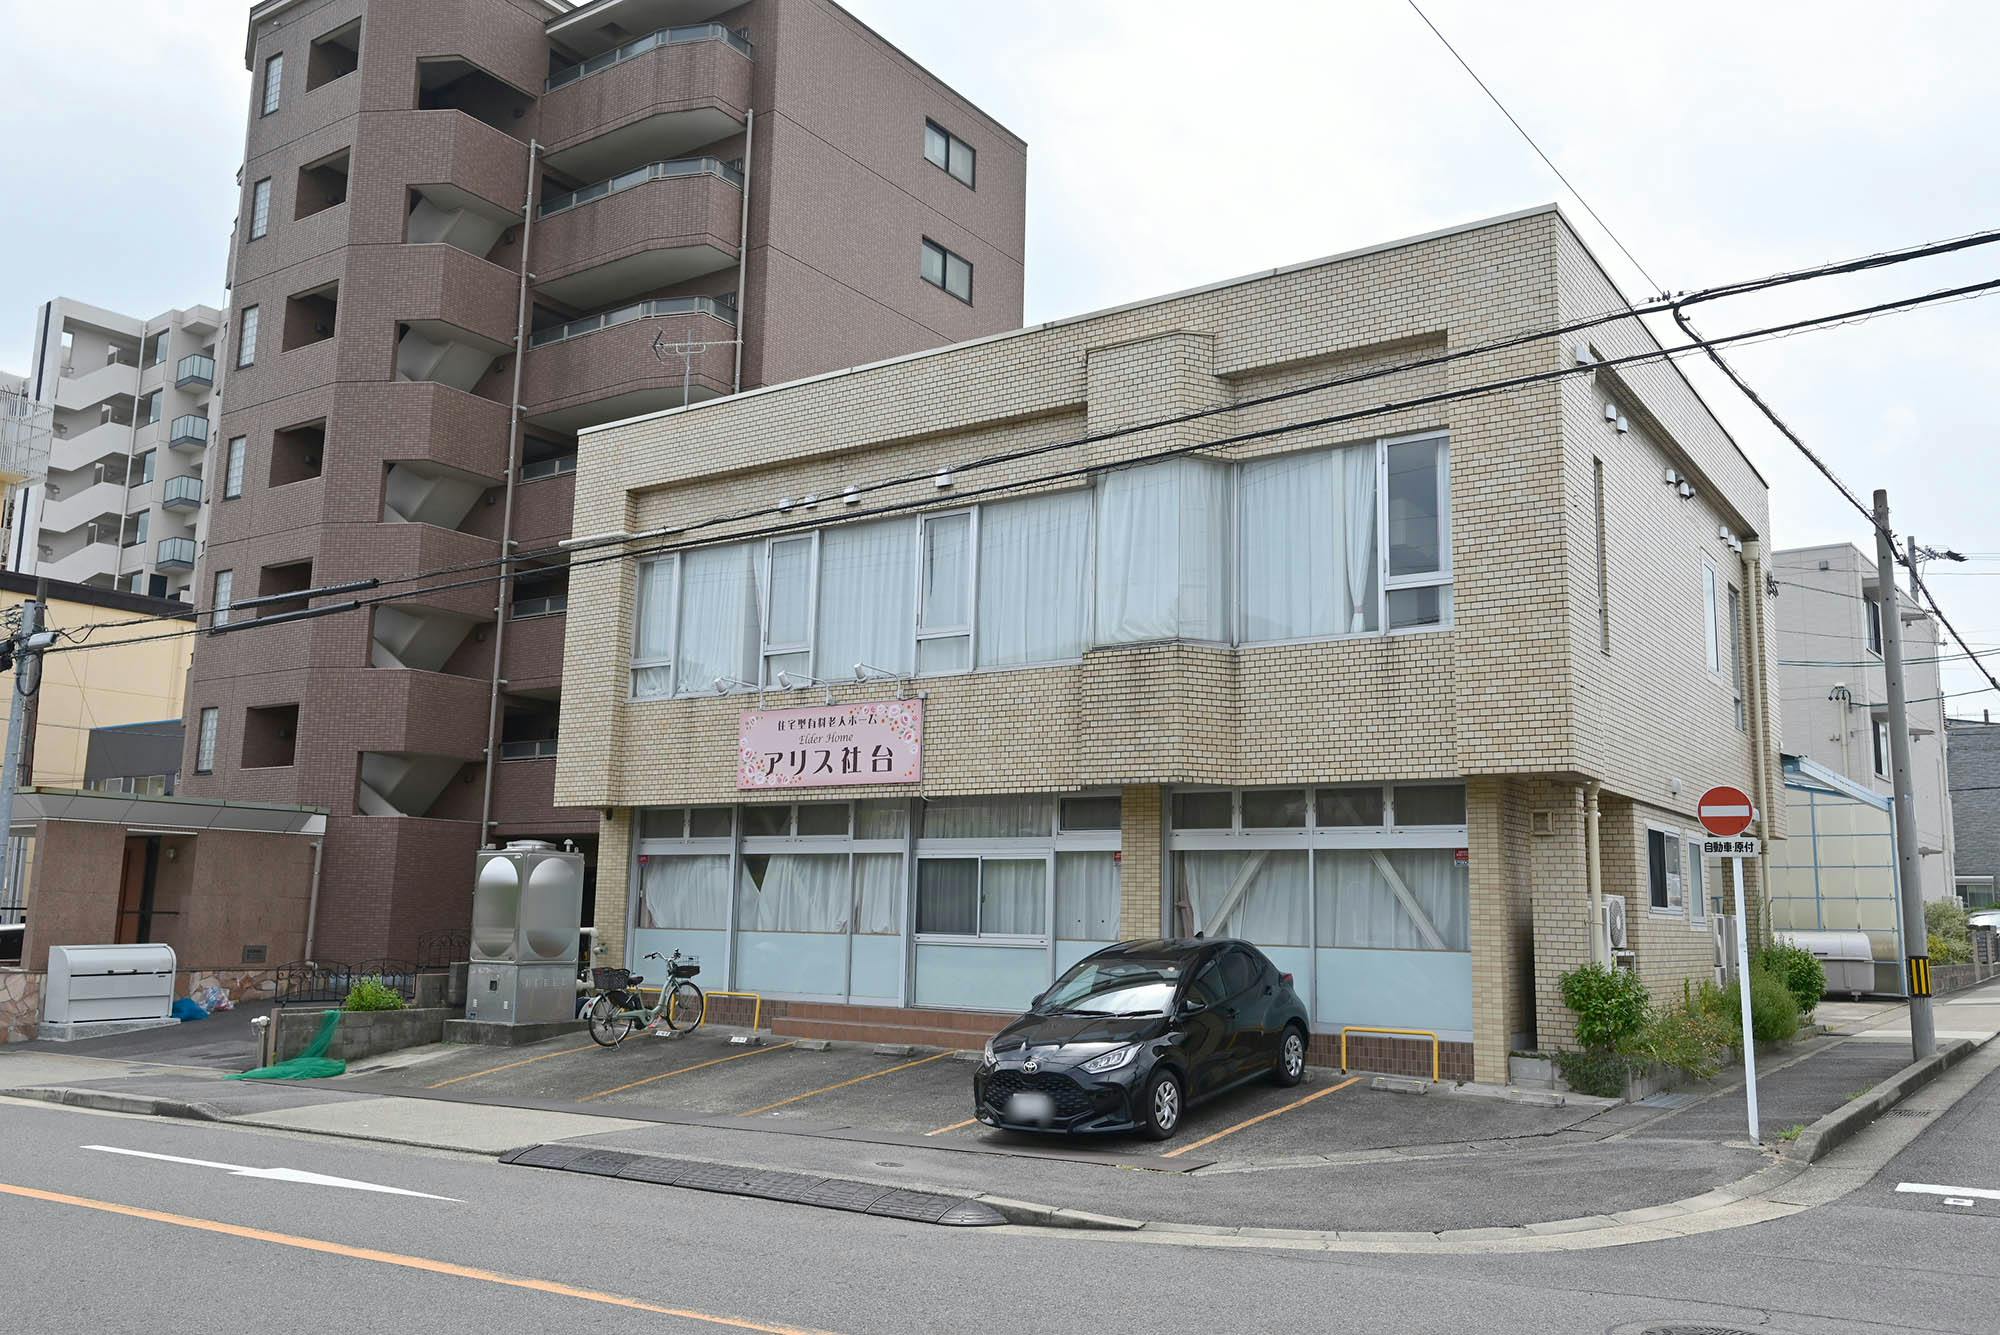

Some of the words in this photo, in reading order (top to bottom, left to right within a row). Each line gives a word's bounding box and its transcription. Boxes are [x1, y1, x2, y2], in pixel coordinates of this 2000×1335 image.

[777, 714, 877, 731] 住宅型有料老人ホーム
[798, 733, 823, 745] Elder
[825, 733, 854, 744] Home
[764, 744, 893, 777] アリス社台
